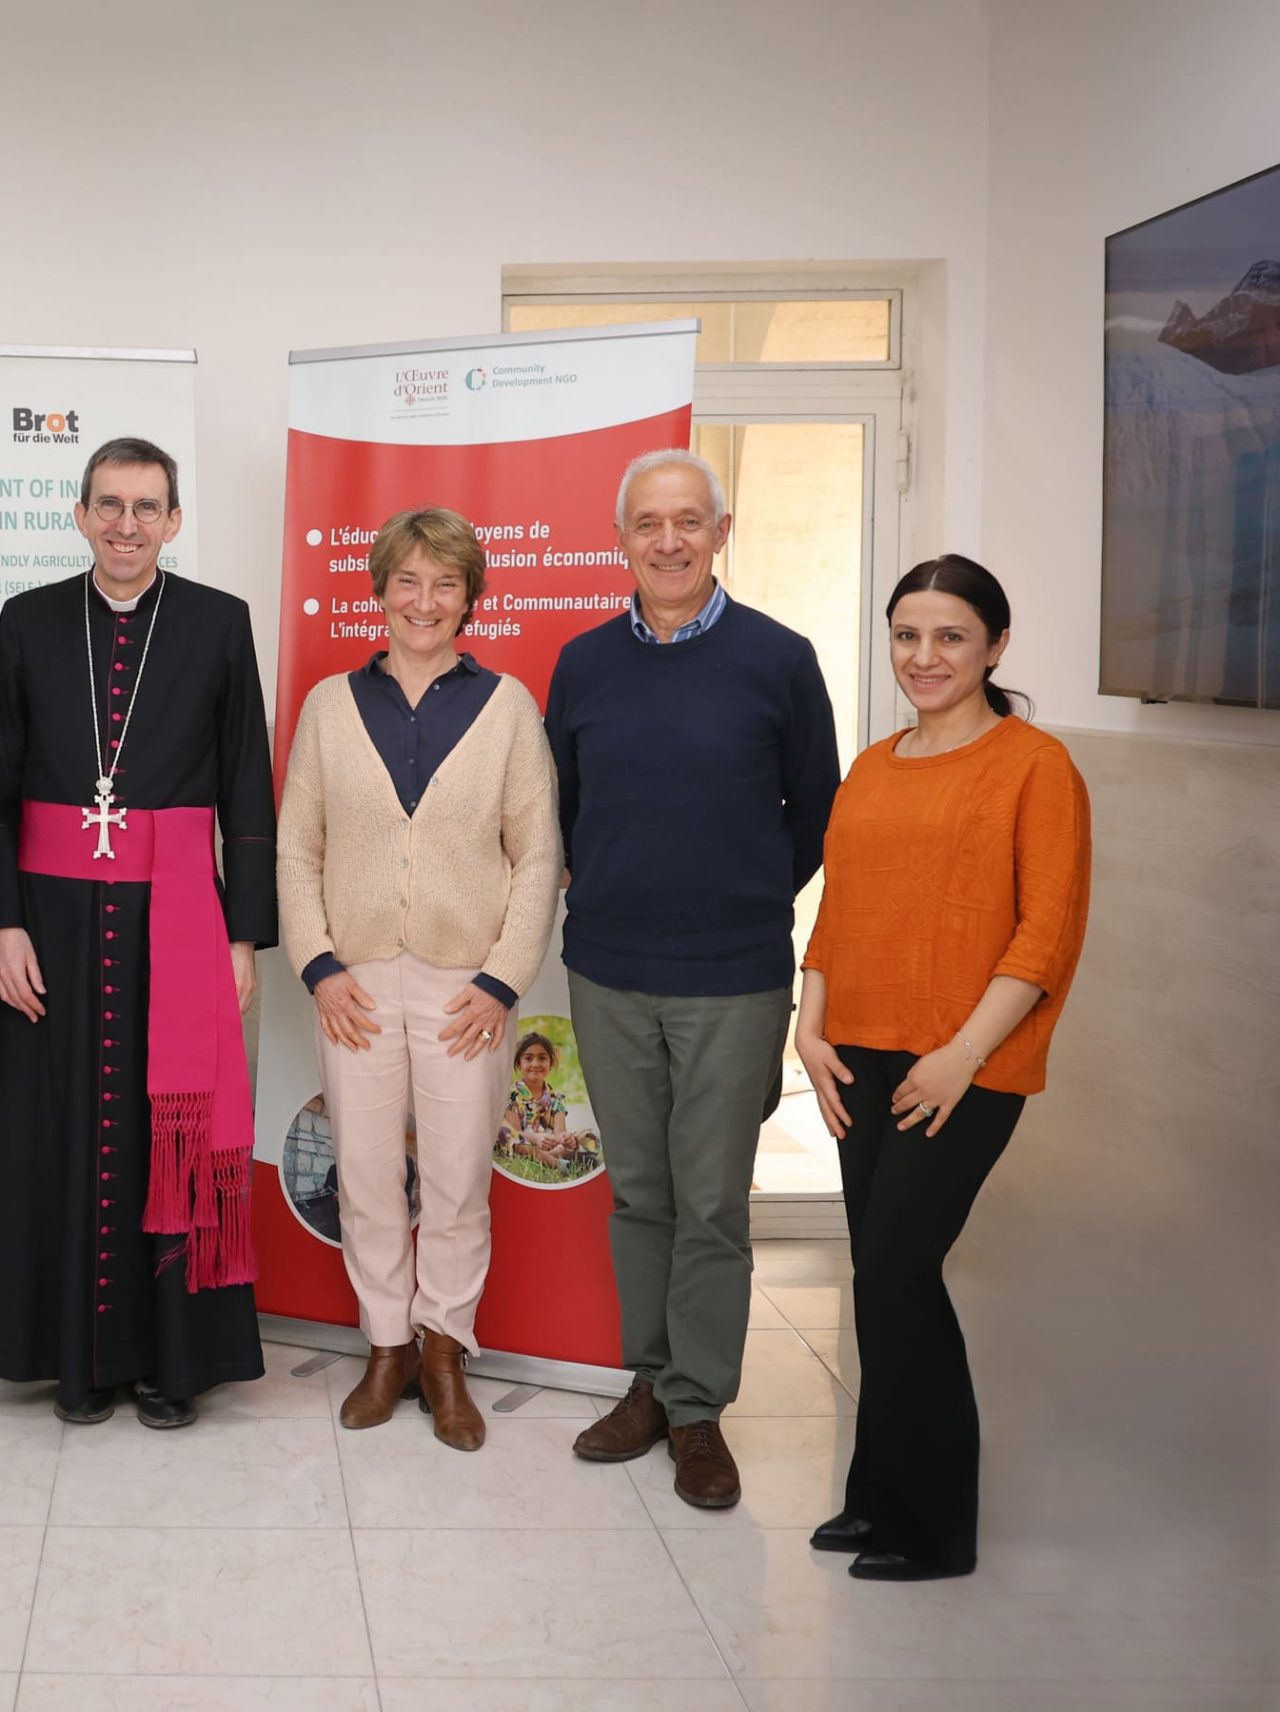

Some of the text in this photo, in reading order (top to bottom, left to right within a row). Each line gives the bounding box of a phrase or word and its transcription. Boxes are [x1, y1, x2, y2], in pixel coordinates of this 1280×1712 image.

[492, 364, 545, 376] Community
[393, 382, 448, 397] d'Orient
[492, 374, 577, 389] Development NGO
[12, 407, 79, 433] Brot
[13, 433, 79, 444] für die Welt
[29, 479, 53, 498] OF
[60, 479, 81, 499] IN
[25, 511, 76, 531] RURA
[330, 521, 550, 546] L'éduc oyens de
[32, 555, 94, 567] AGRICULTU
[329, 546, 629, 573] subsi lusion économiq
[332, 598, 348, 614] La
[483, 594, 498, 611] et
[503, 592, 632, 611] Communautaire
[330, 618, 521, 641] L'intégra efugiés
